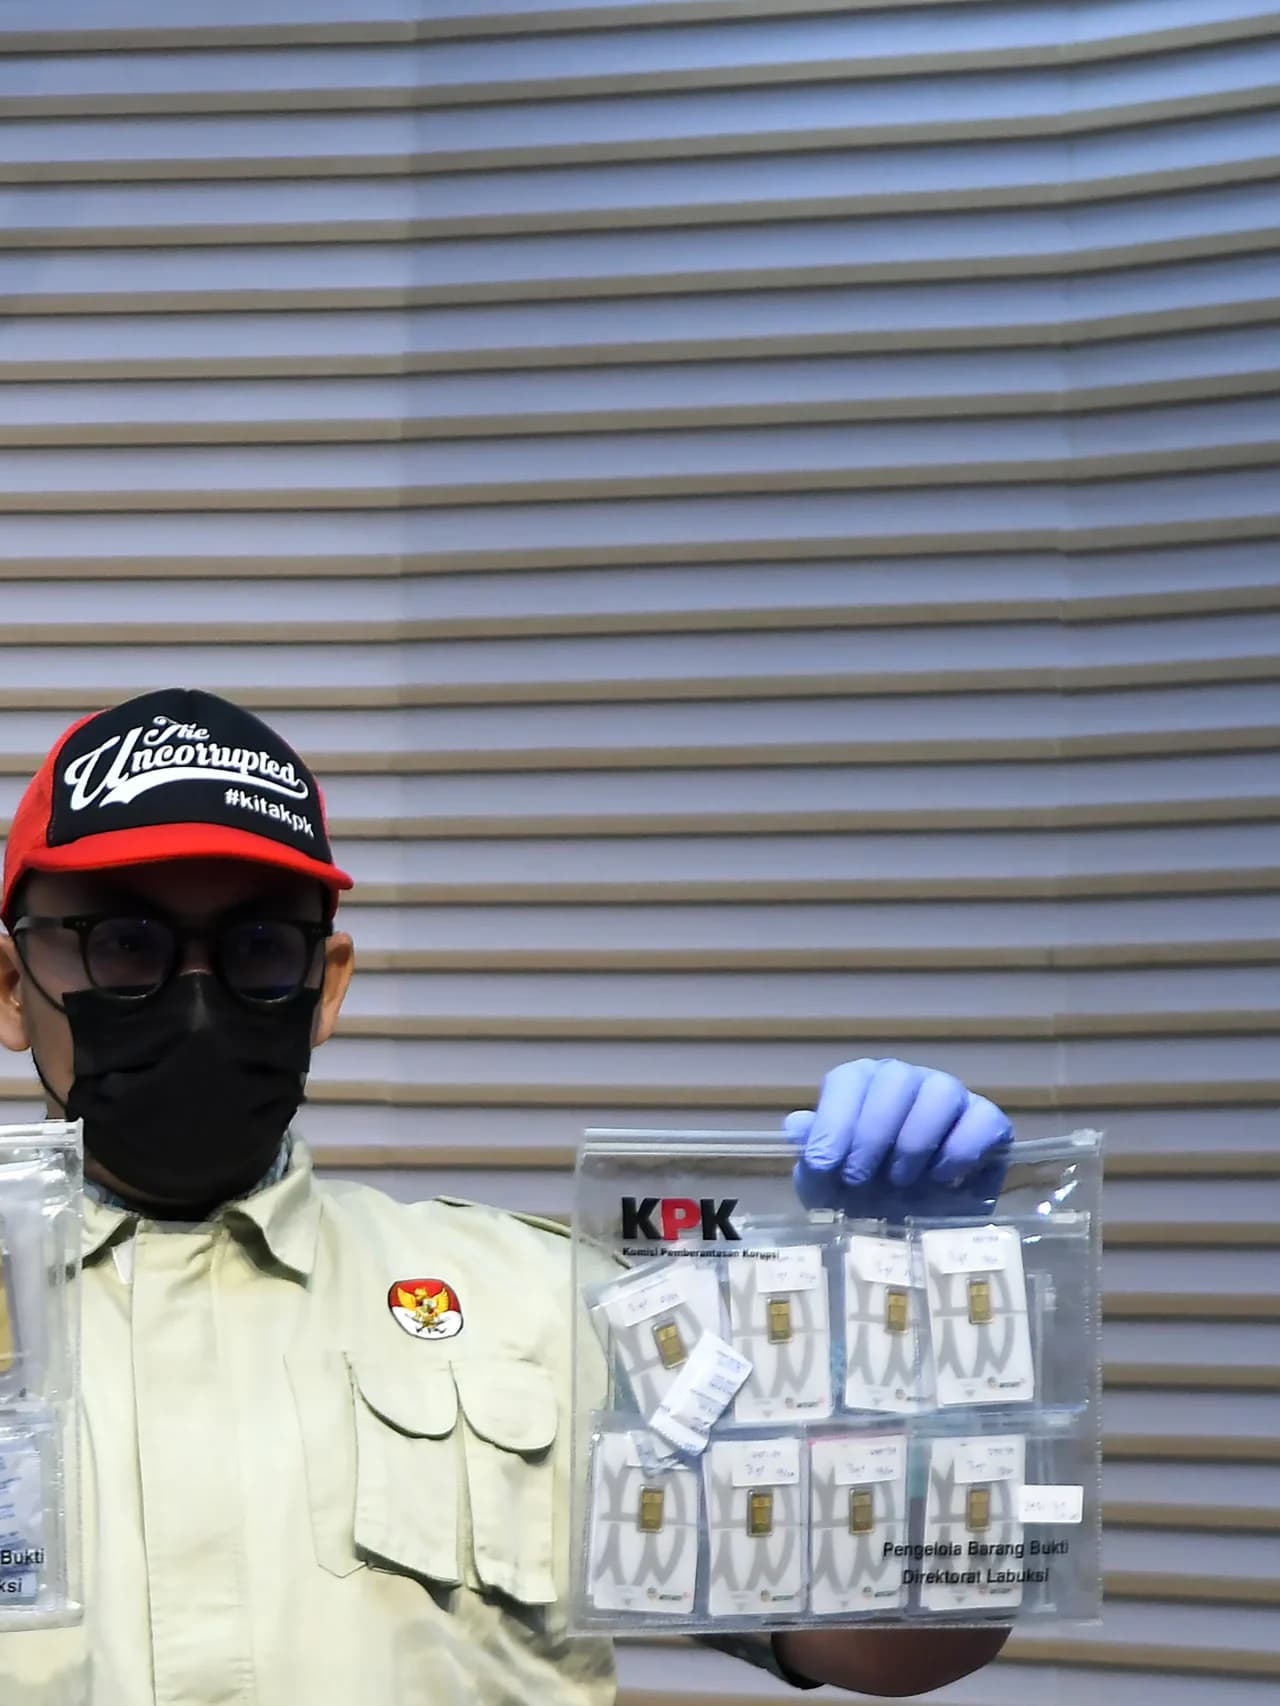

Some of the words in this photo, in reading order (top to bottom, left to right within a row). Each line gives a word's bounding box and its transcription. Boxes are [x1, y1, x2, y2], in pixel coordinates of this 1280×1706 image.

[142, 715, 211, 747] The
[64, 727, 300, 811] Uncorrupted
[224, 787, 315, 839] #kitakpk
[621, 1197, 743, 1241] KPK
[0, 1548, 44, 1565] Bukti
[883, 1542, 962, 1560] Pengelola
[968, 1541, 1024, 1559] Barang
[1030, 1540, 1069, 1555] Bukti
[902, 1569, 982, 1585] Direktorat
[987, 1567, 1050, 1584] Labuksi
